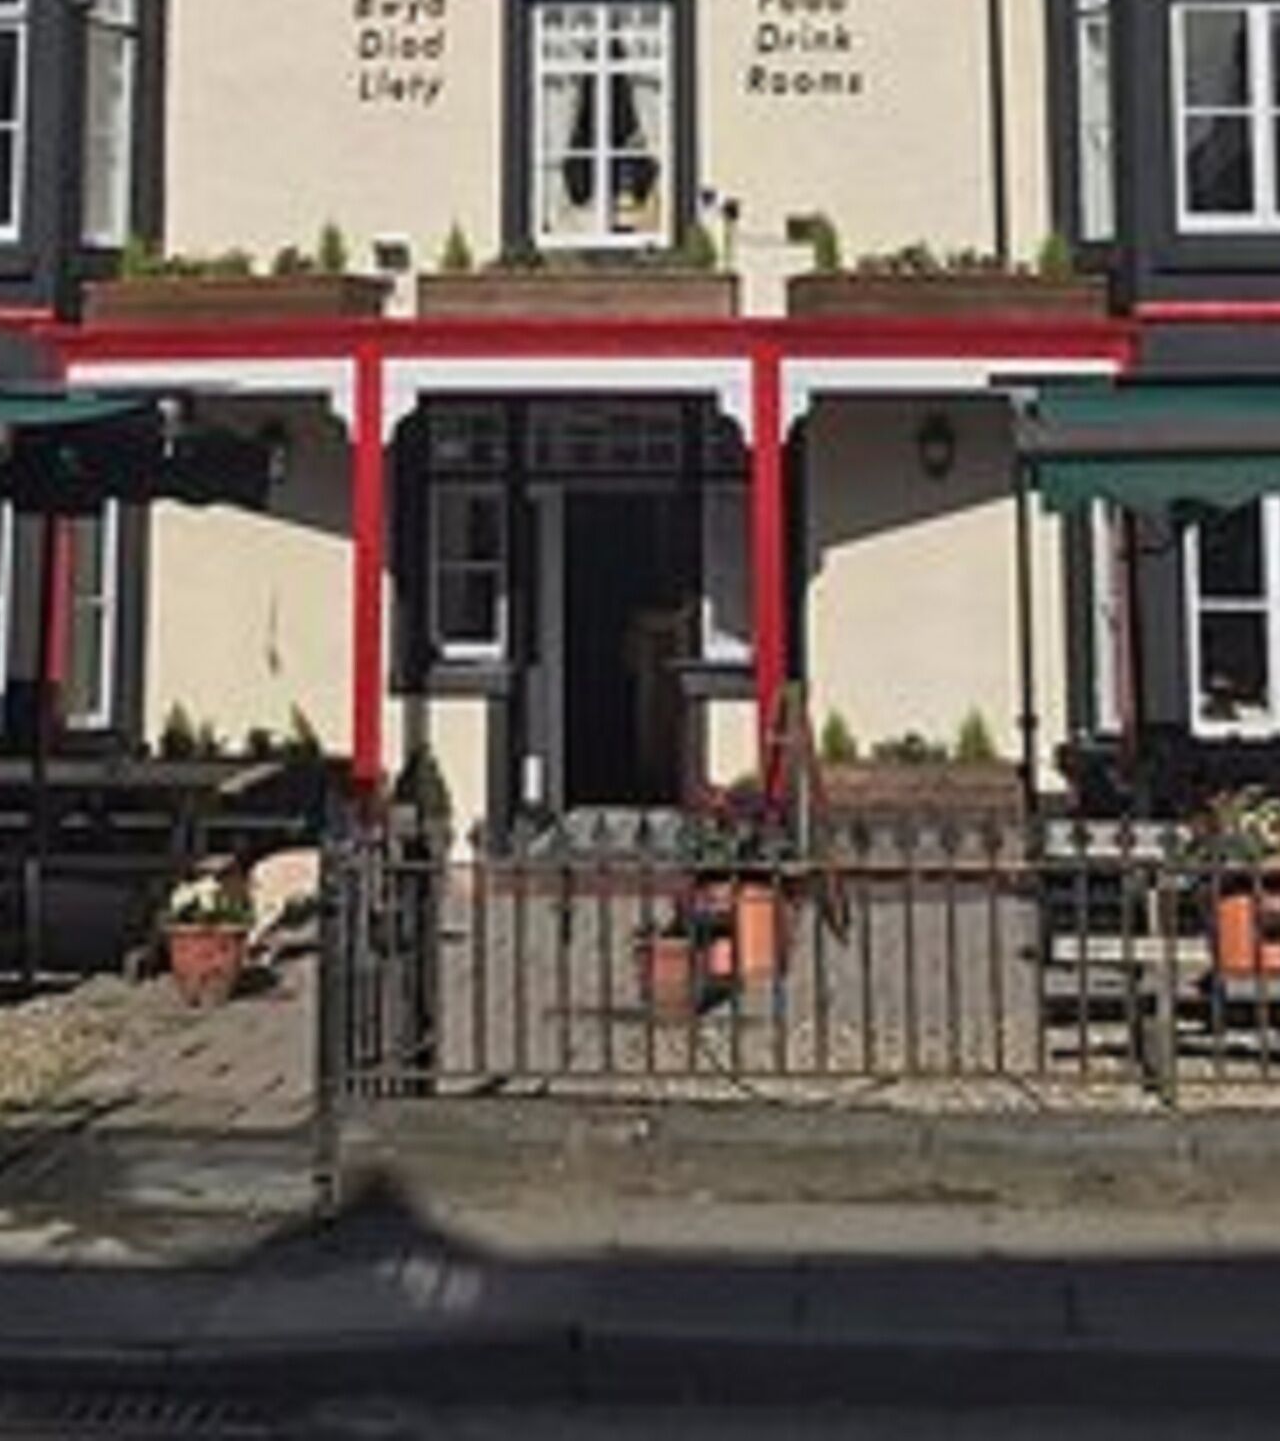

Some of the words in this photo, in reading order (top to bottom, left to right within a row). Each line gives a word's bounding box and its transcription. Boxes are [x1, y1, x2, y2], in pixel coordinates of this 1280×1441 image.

[359, 27, 446, 59] Diod
[757, 21, 851, 54] Drink
[745, 64, 863, 95] Rooms
